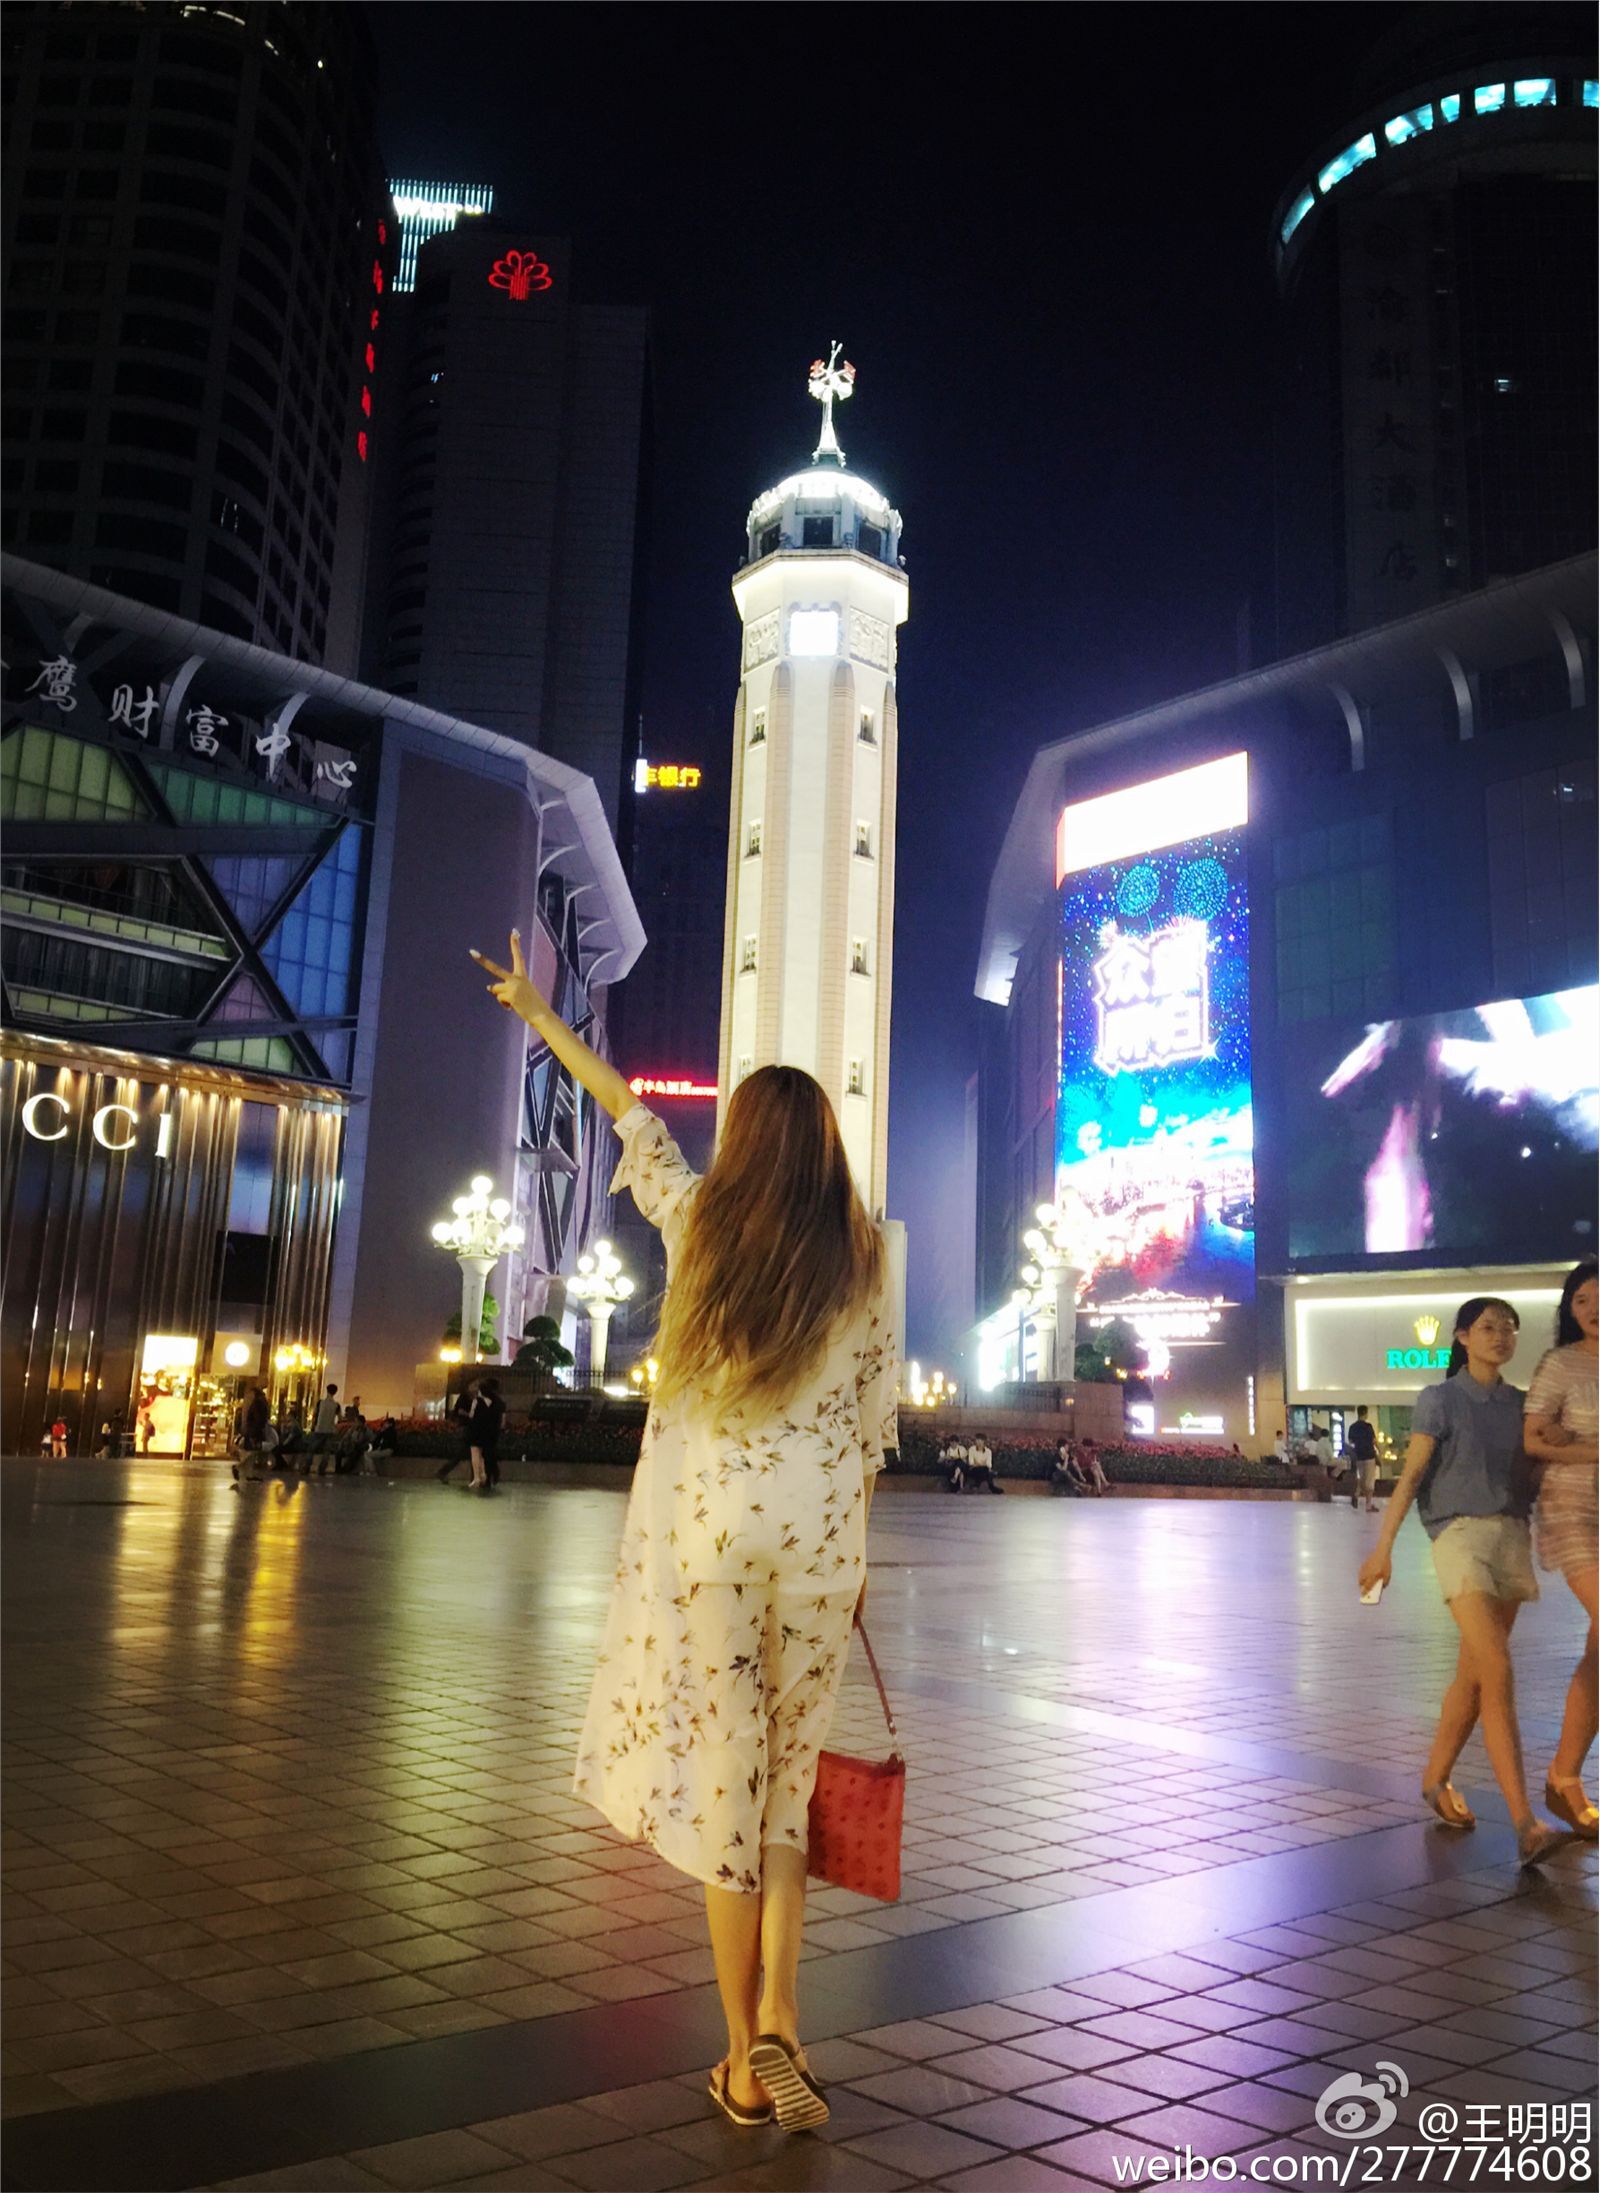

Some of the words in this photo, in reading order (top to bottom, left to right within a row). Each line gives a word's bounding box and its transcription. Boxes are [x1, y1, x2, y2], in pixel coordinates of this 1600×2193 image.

[2, 654, 358, 788] 鹰财富中心
[1104, 934, 1201, 1004] 众
[1386, 1348, 1453, 1369] ROLE
